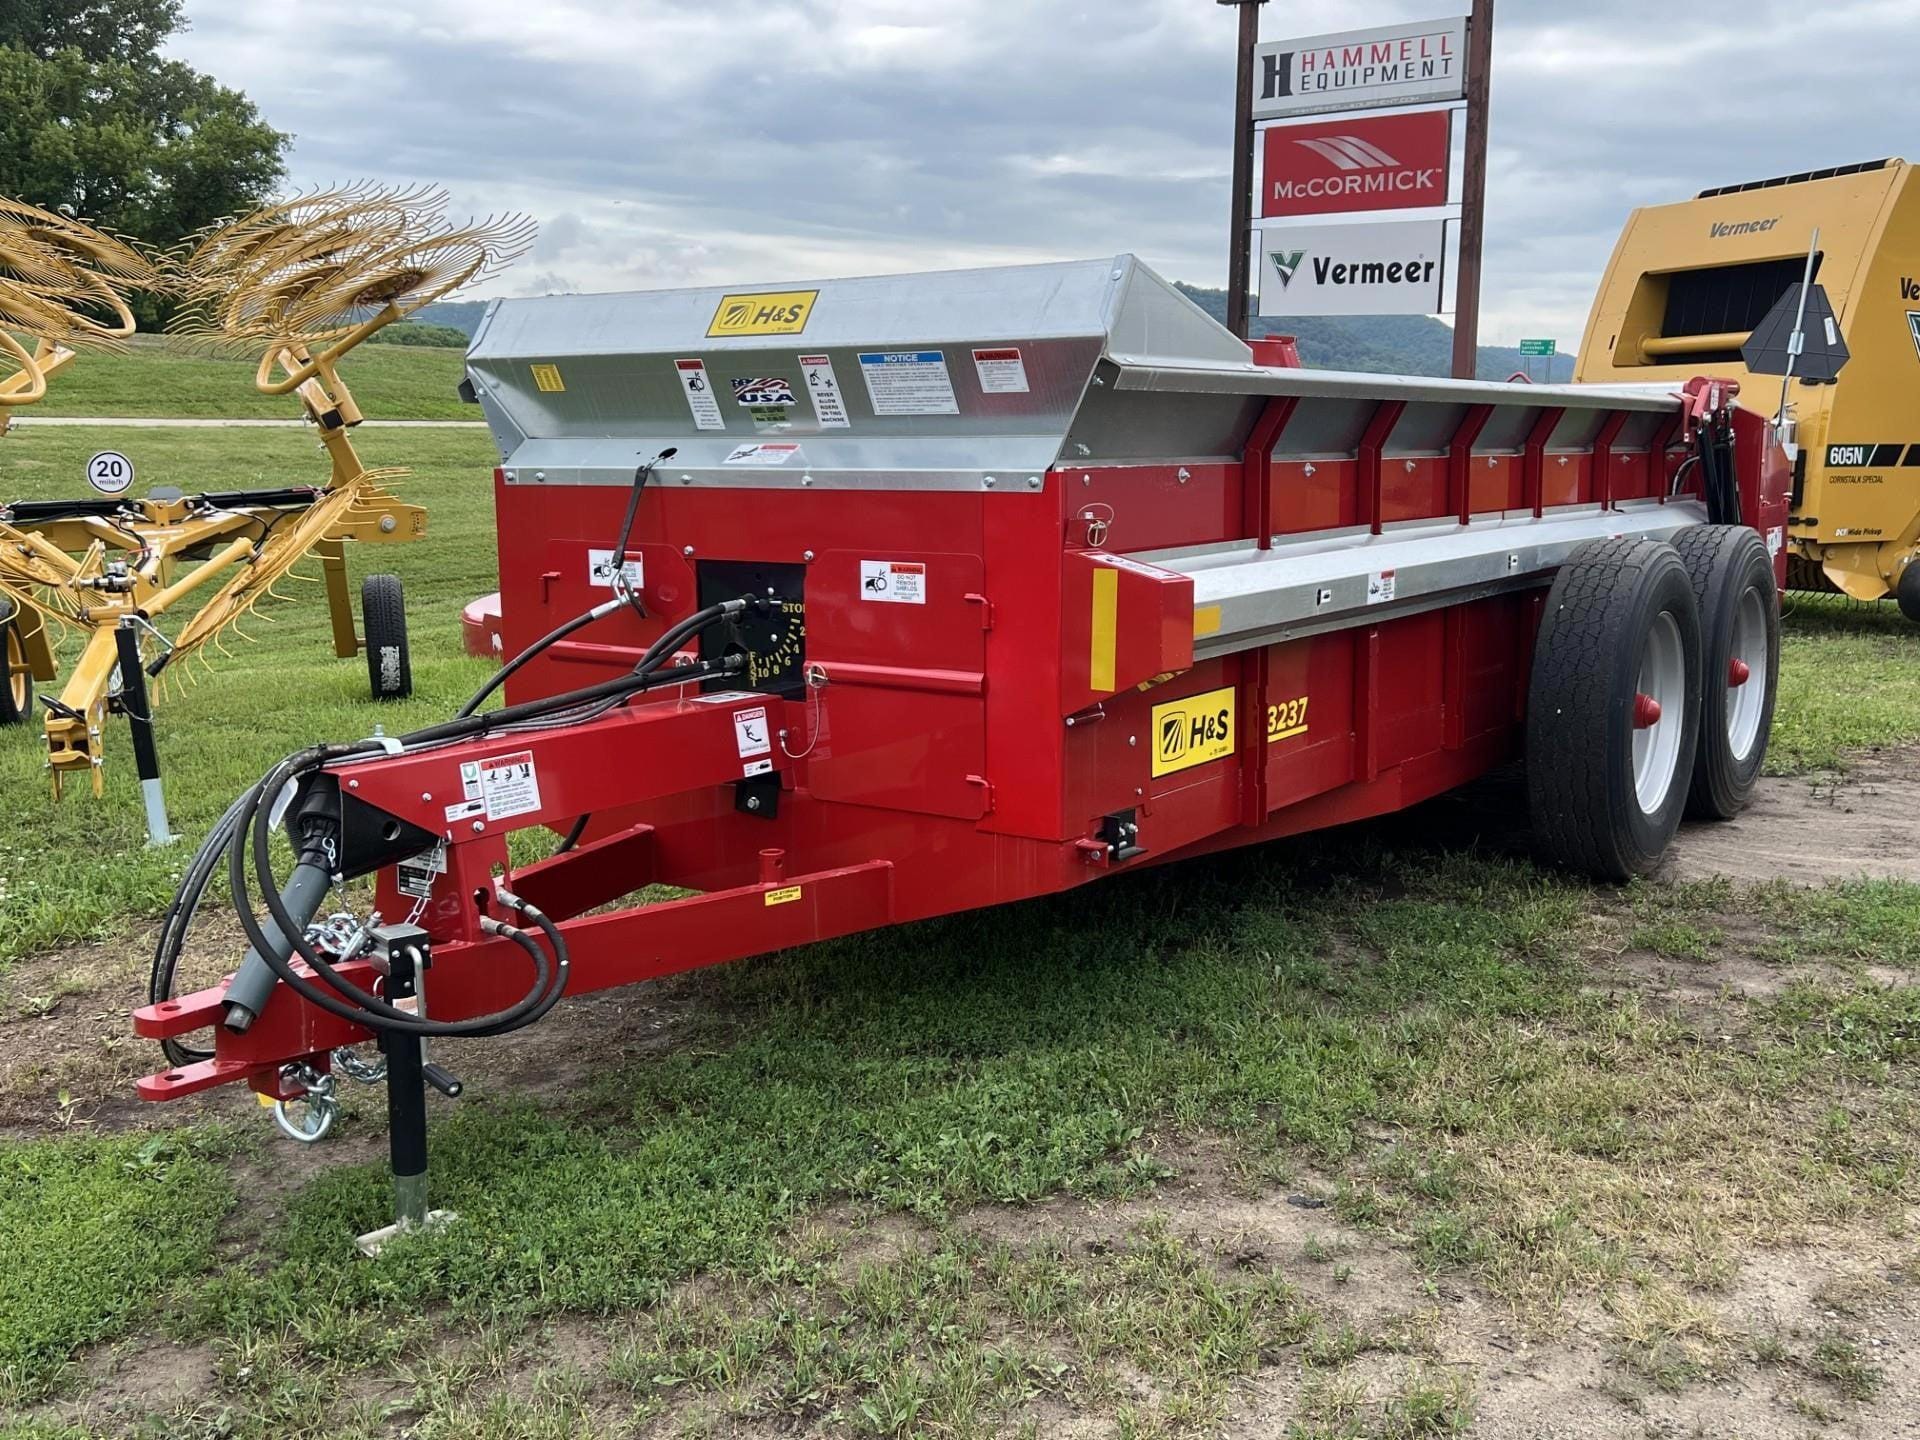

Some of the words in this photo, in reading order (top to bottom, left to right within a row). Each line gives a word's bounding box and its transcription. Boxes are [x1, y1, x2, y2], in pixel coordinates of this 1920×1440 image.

[1302, 36, 1453, 73] HAMMELL
[1301, 58, 1453, 91] EQUIPMENT
[1709, 217, 1779, 238] Vermeer
[1313, 257, 1435, 285] Vermeer
[751, 304, 804, 325] H&S
[884, 354, 918, 362] NOTICE
[738, 394, 796, 403] USA
[1830, 446, 1863, 465] 605N
[97, 460, 122, 477] 20
[1829, 475, 1861, 484] CORNSTALK
[1862, 475, 1884, 484] SPECIAL
[1863, 528, 1882, 536] Pickup
[800, 626, 806, 636] 2
[793, 644, 799, 653] 4
[749, 651, 757, 687] FAST
[773, 665, 780, 674] 8
[785, 656, 791, 666] 6
[758, 668, 769, 677] 10
[1268, 696, 1308, 733] 3237
[1190, 709, 1229, 749] H&S
